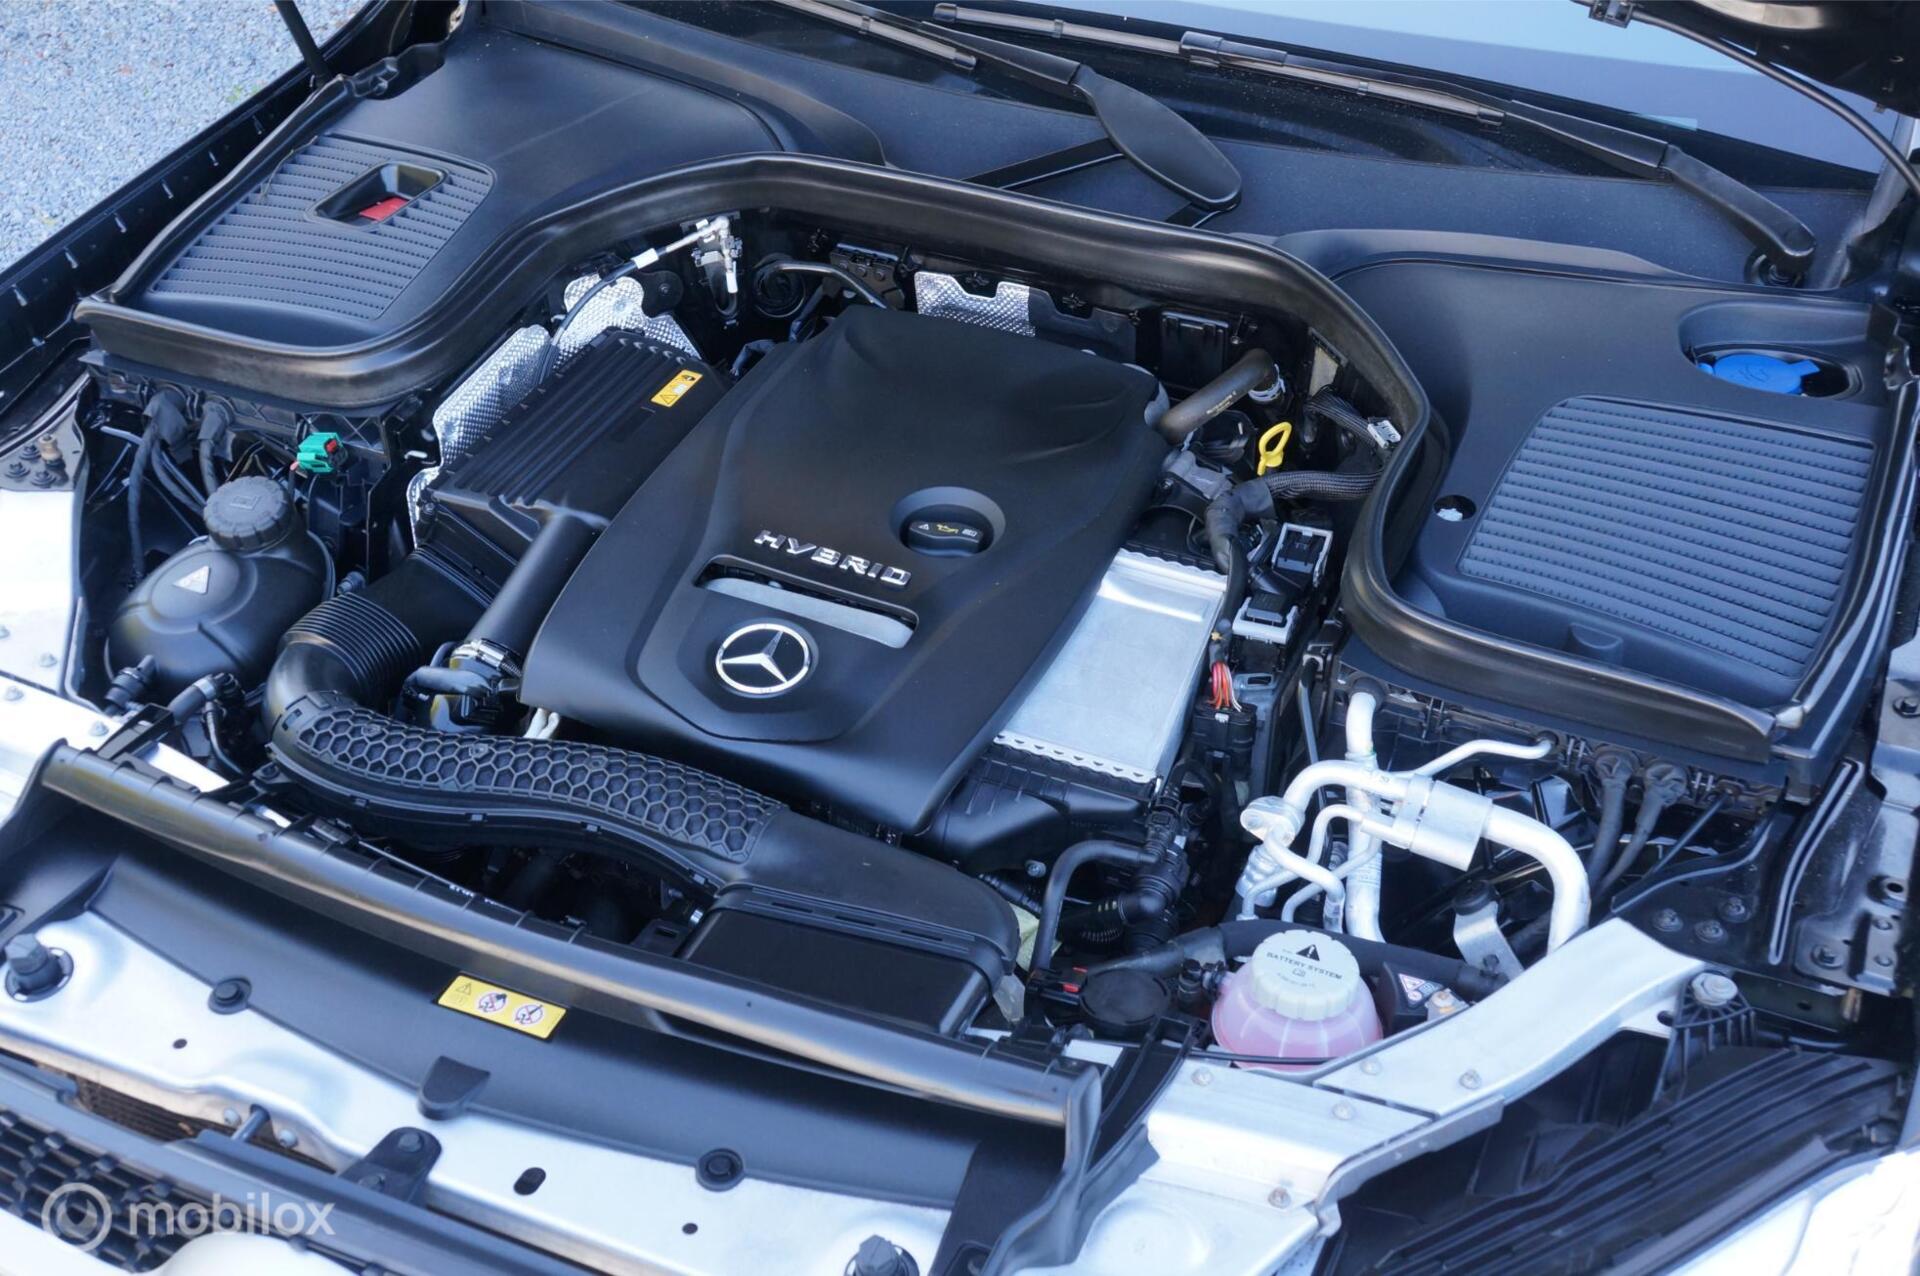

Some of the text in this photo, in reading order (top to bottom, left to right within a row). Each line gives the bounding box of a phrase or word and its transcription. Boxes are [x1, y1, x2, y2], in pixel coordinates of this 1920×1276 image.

[753, 529, 912, 586] HYBRID
[1266, 951, 1305, 968] BATTERY
[1307, 964, 1343, 980] SYSTEM
